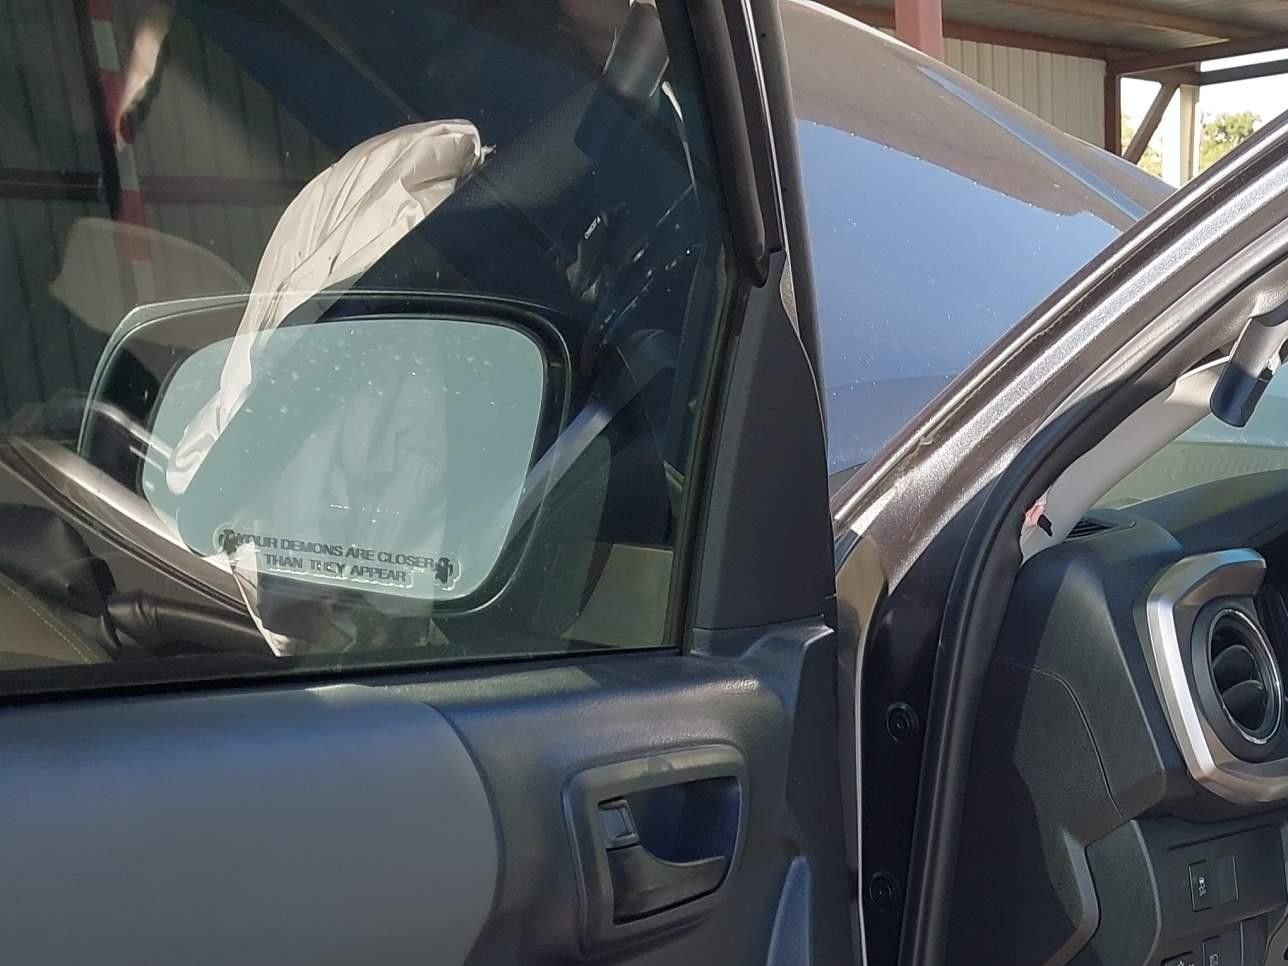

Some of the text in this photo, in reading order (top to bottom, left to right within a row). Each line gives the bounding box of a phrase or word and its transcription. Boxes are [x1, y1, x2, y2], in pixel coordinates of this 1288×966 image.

[237, 532, 434, 568] YOUR DEMONS ARE CLOSER
[264, 553, 407, 582] THAN THEY APPEAR
